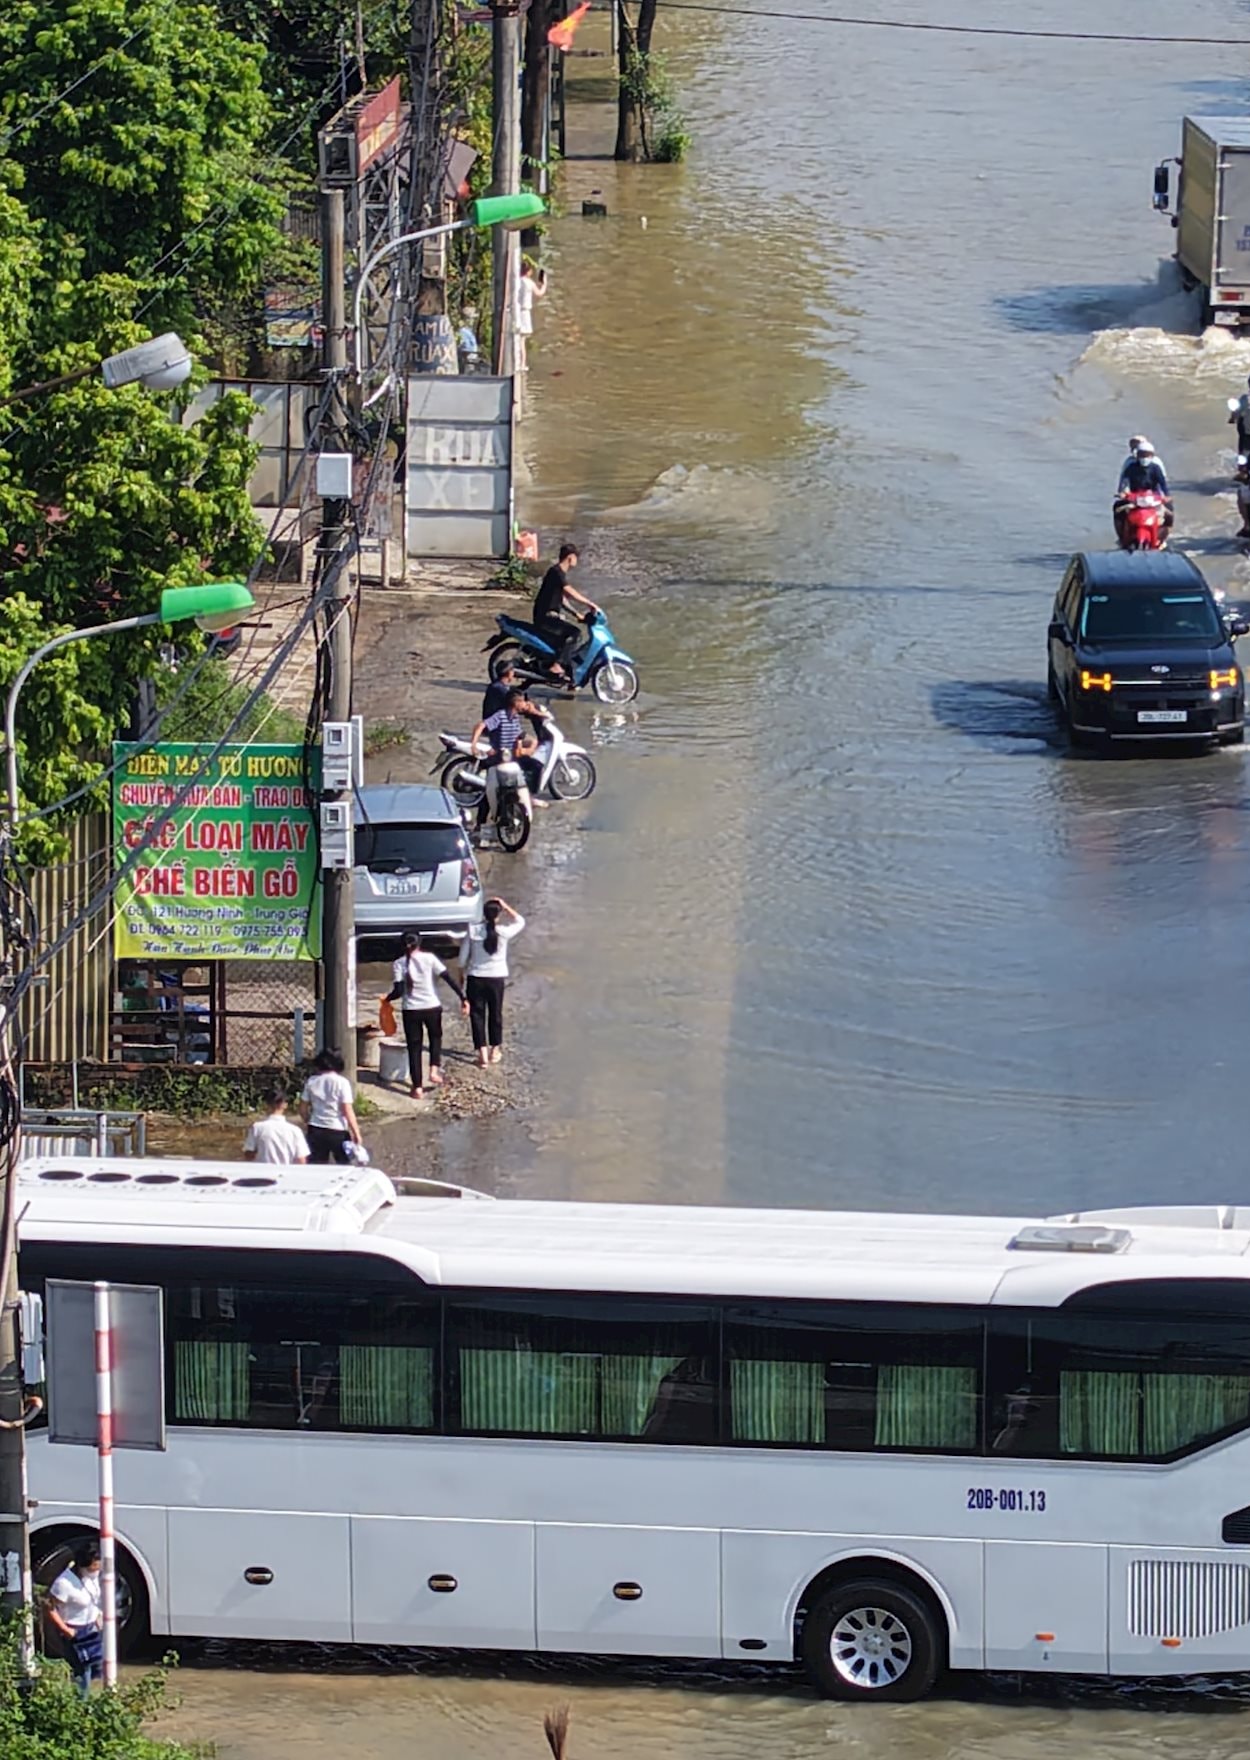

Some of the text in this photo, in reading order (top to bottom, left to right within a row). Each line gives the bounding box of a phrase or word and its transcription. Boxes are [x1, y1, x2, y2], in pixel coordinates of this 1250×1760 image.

[185, 821, 243, 857] LOẠI
[251, 816, 310, 852] MÁY
[133, 857, 300, 898] CHẾ BIẾN GỖ
[966, 1487, 1047, 1512] 20B-001.13
